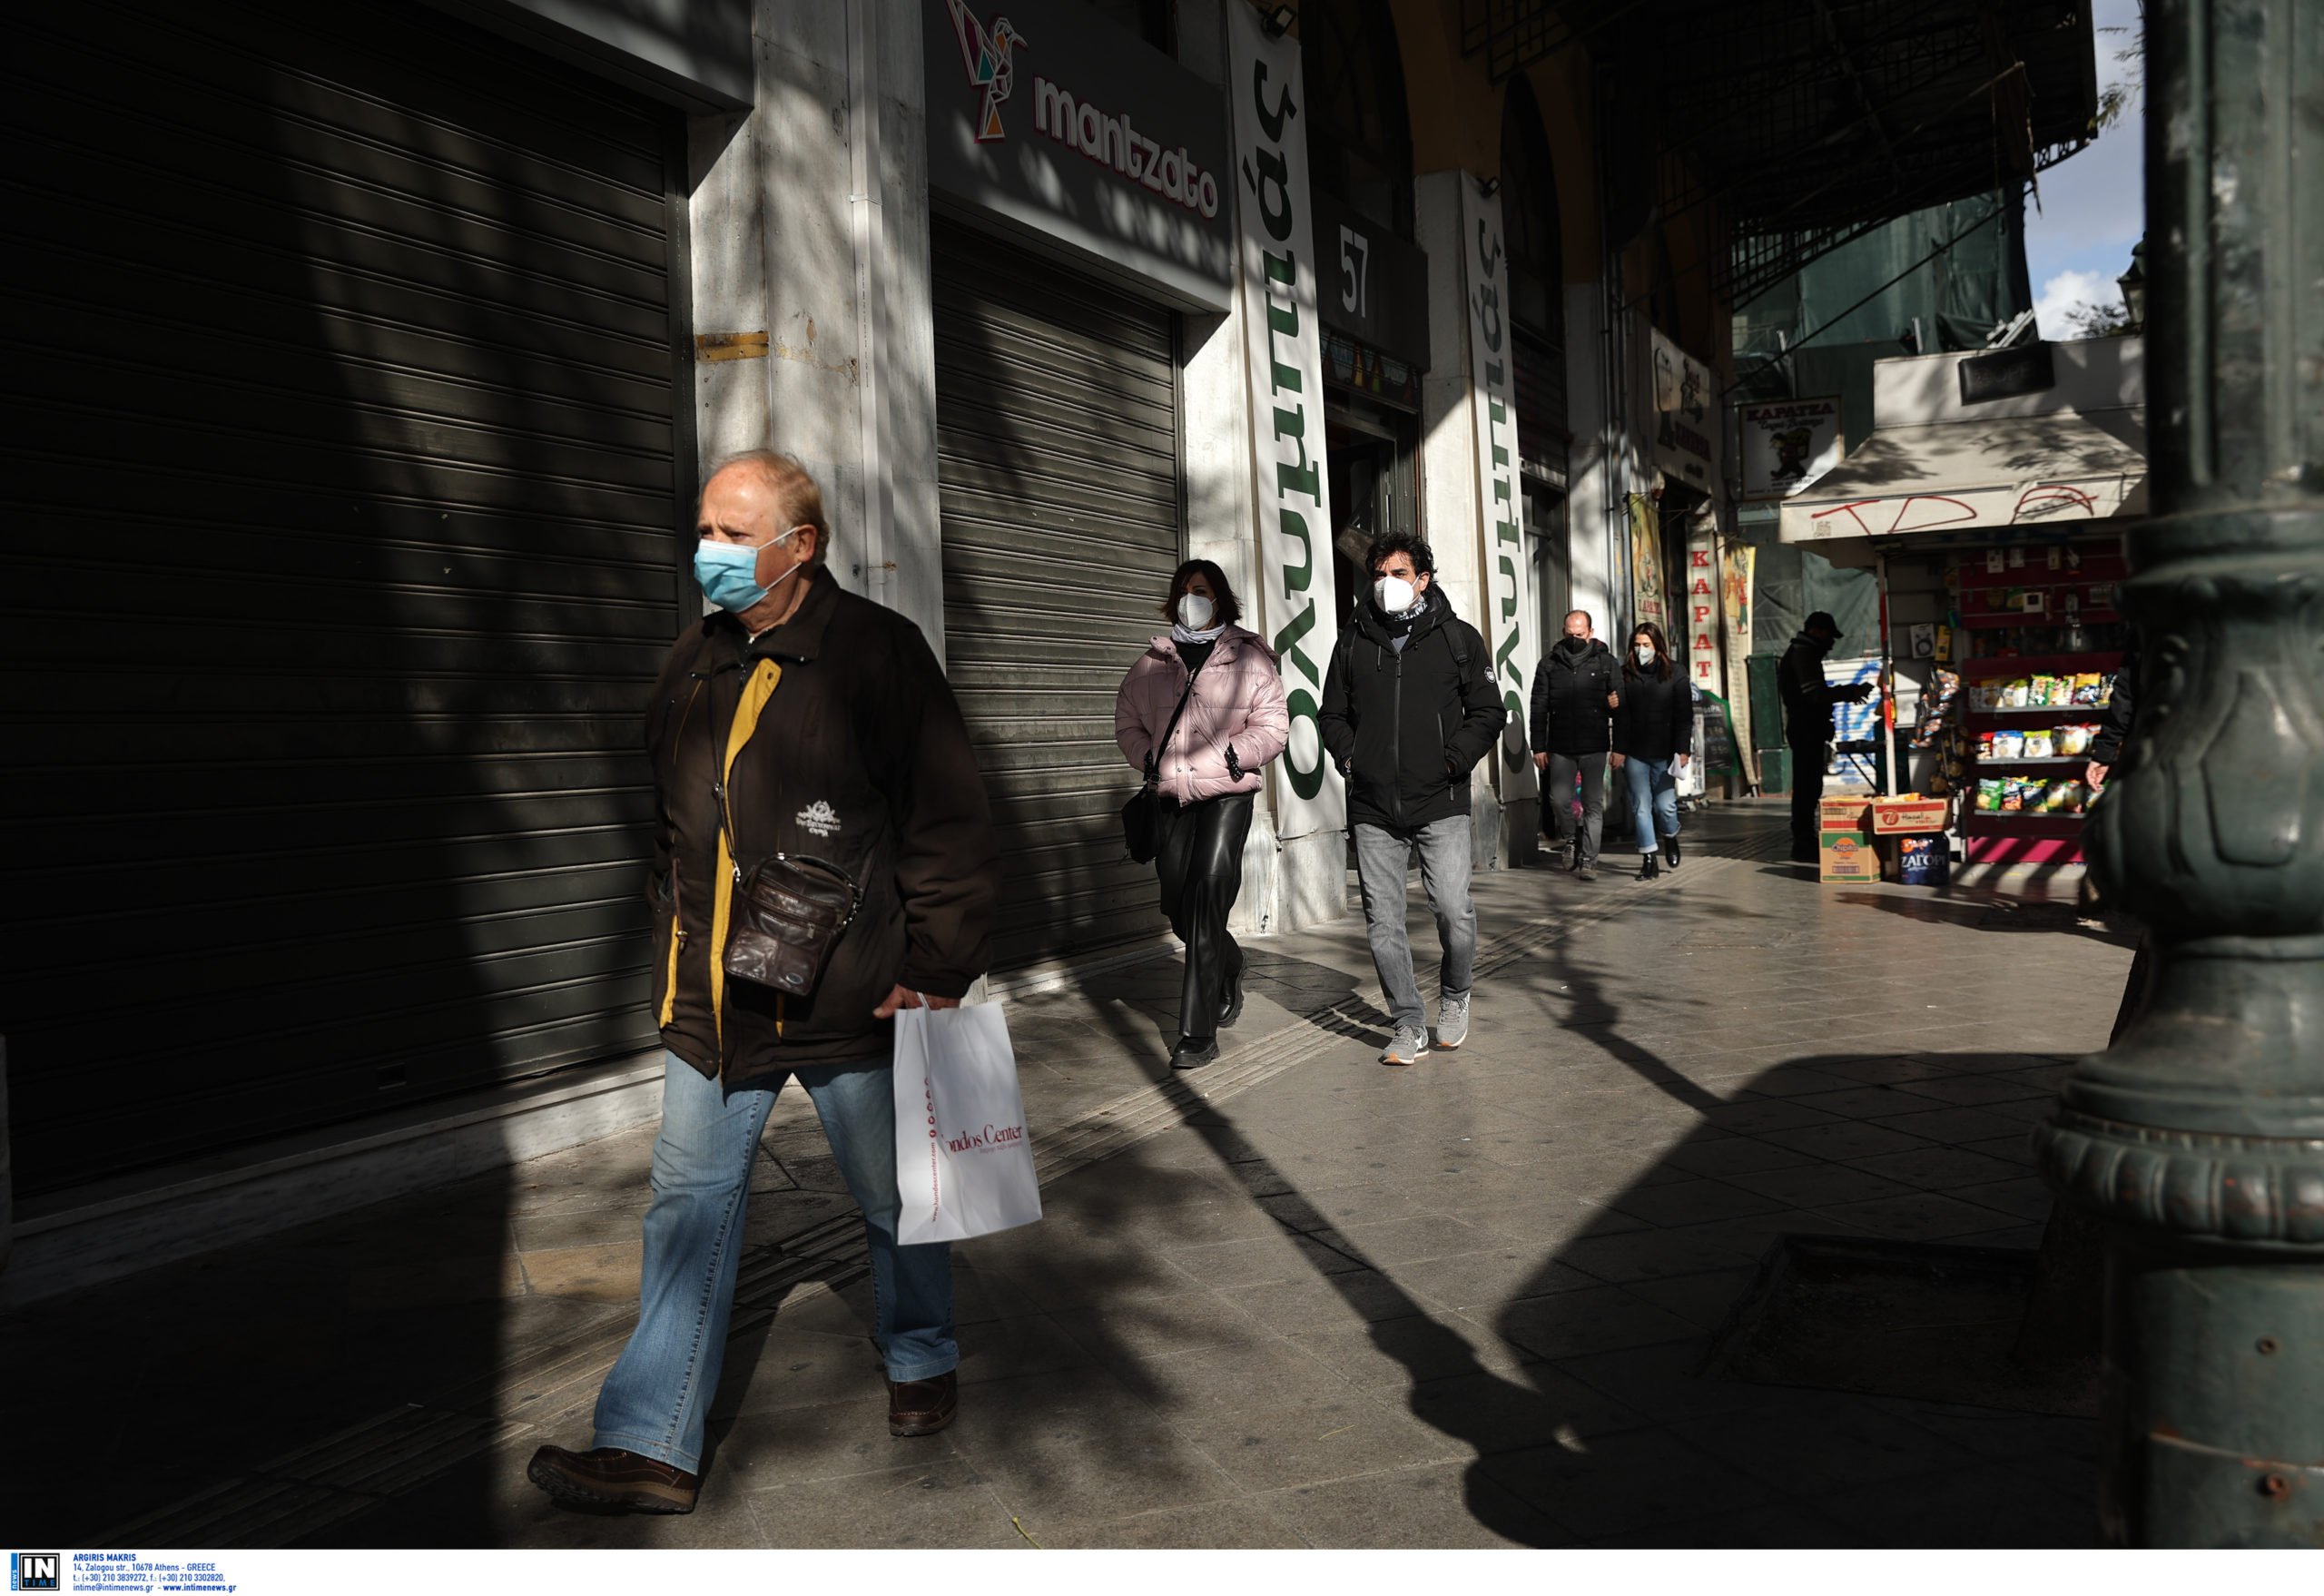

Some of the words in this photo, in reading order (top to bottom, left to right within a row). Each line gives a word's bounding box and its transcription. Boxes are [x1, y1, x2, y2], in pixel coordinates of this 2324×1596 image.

[1034, 75, 1219, 219] mantzato
[1339, 223, 1369, 319] 57
[1242, 59, 1325, 801] ολυμπιάς
[1469, 218, 1527, 774] ολυμπιάς
[1691, 551, 1713, 692] ΚΑΡΑΤ
[941, 1129, 983, 1153] ondos
[984, 1124, 1023, 1145] Center
